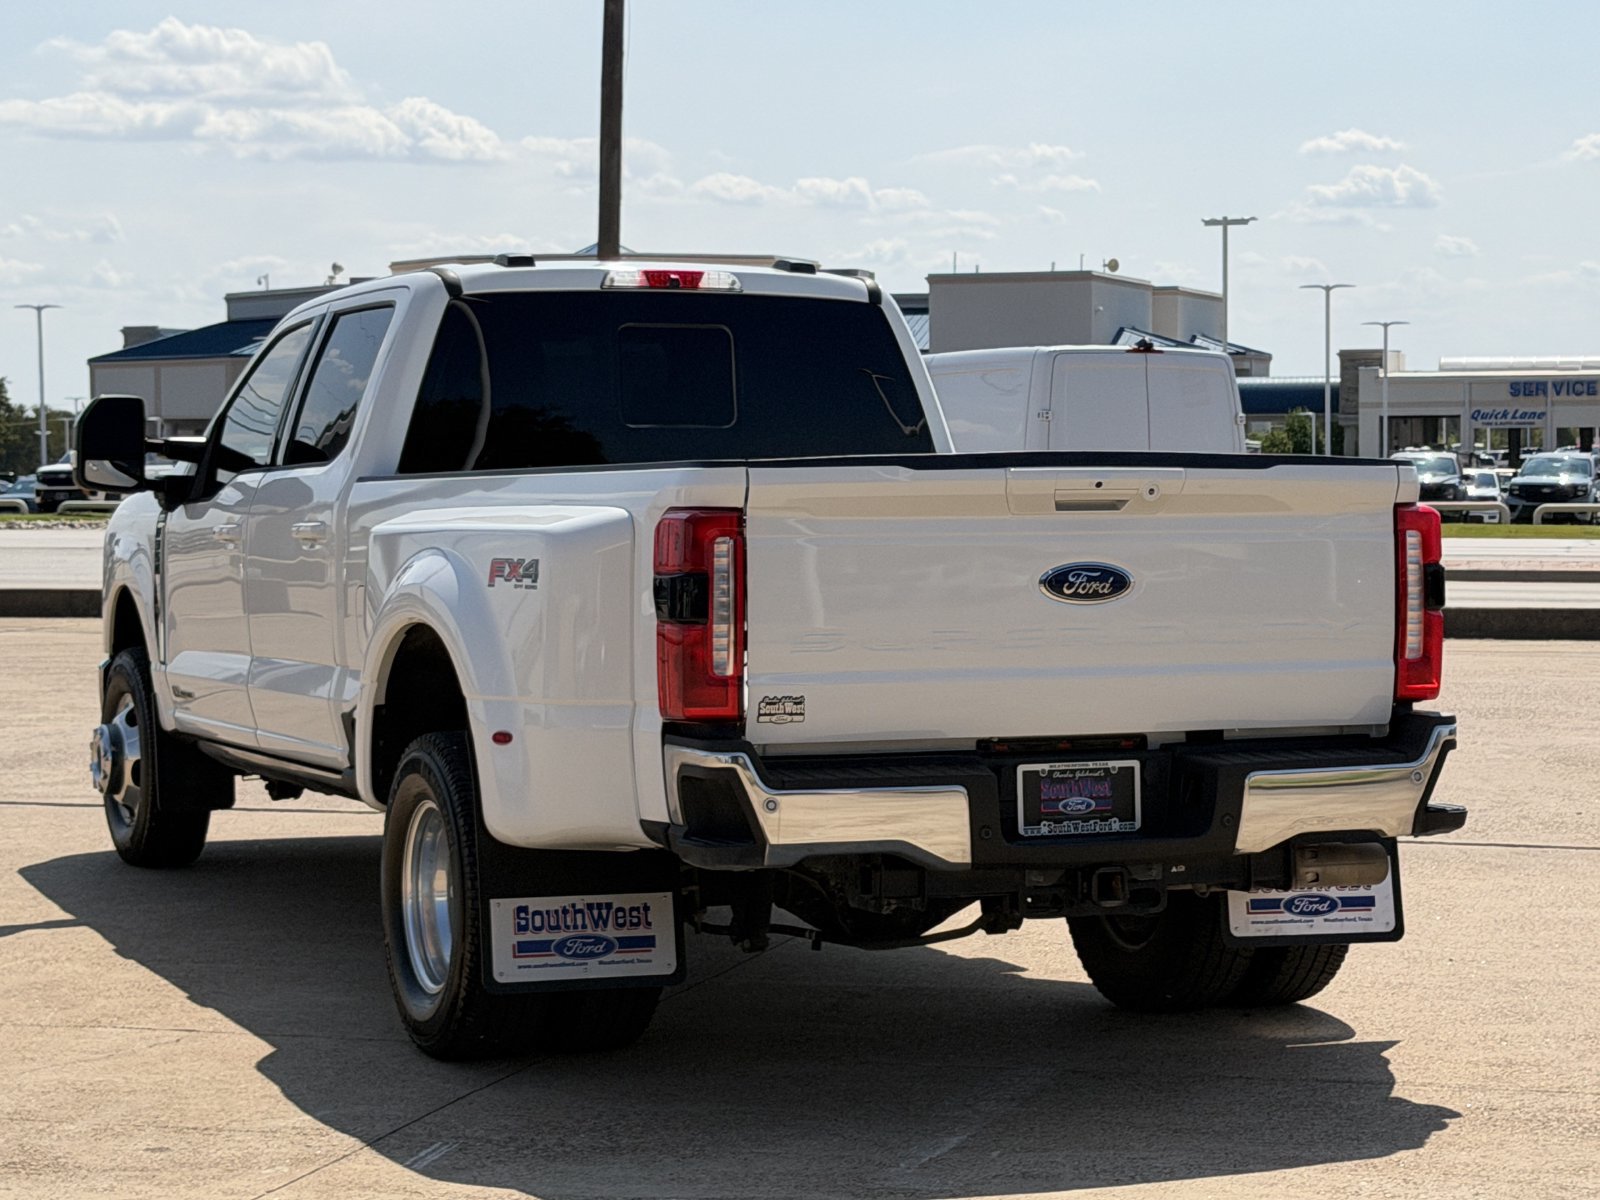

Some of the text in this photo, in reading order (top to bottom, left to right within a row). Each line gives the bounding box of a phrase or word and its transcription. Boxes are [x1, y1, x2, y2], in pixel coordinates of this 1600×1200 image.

[1509, 380, 1598, 397] SERVICE
[1471, 408, 1547, 421] Quick Lane
[487, 558, 540, 588] FX4
[1062, 570, 1115, 595] Ford
[1066, 799, 1087, 811] Ford
[1291, 897, 1332, 912] Ford
[512, 902, 653, 935] SouthWest
[563, 938, 606, 955] Ford
